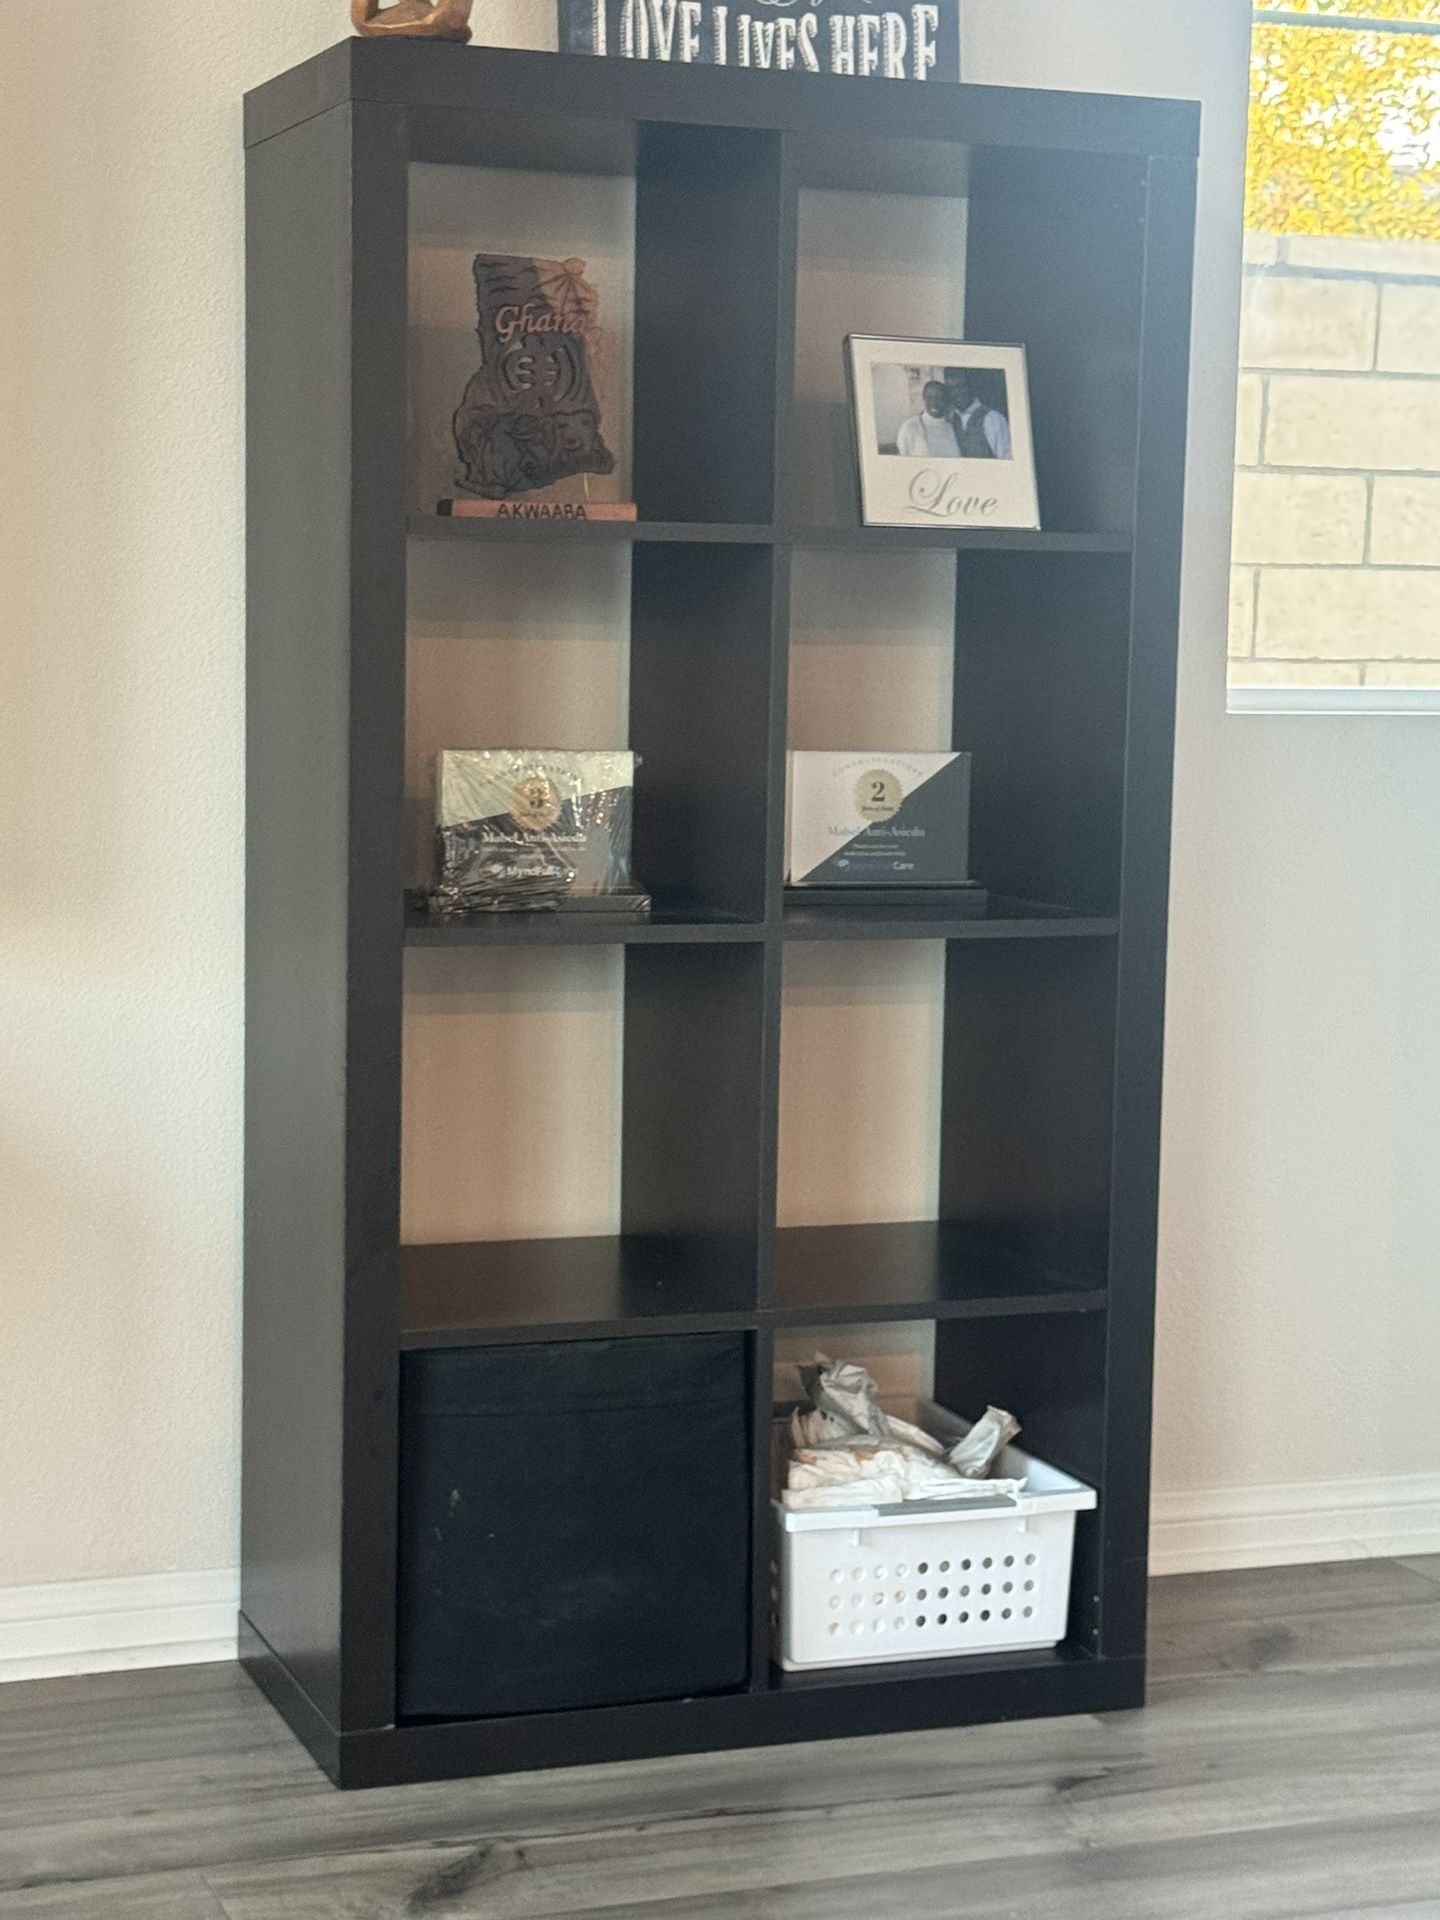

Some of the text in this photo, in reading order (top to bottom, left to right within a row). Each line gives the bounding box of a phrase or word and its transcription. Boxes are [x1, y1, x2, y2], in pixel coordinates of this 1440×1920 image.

[829, 3, 939, 81] HERE
[495, 303, 586, 343] Ghana
[496, 503, 588, 520] AKWAABA
[904, 468, 999, 518] Love
[870, 781, 886, 802] 2
